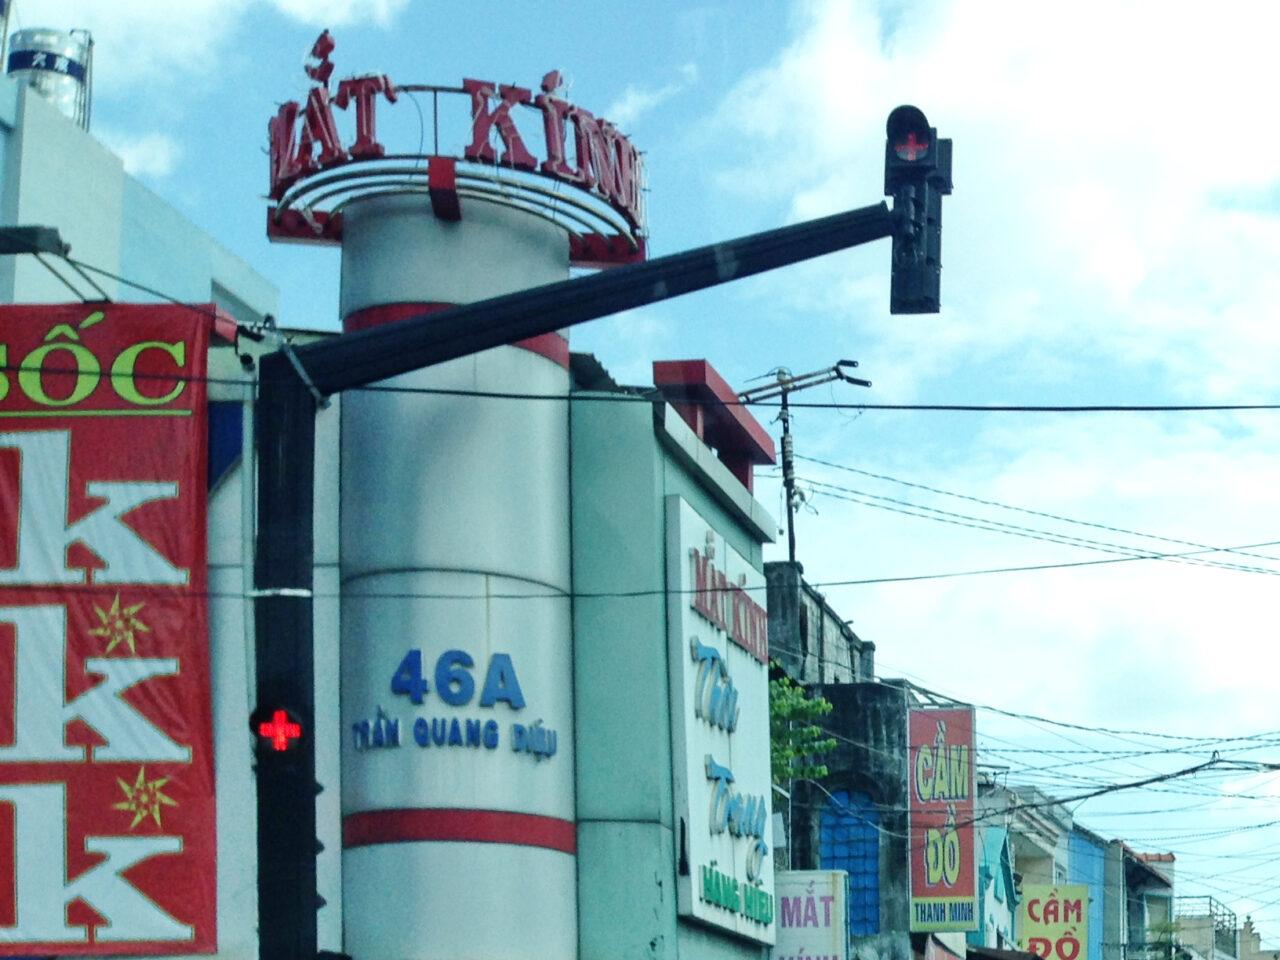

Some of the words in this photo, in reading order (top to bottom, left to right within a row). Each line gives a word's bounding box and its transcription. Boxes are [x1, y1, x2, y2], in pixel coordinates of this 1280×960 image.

[0, 311, 187, 404] ỐC
[391, 648, 526, 710] 46A
[413, 717, 499, 749] QUANG
[916, 720, 969, 803] CẦM
[925, 805, 961, 888] ĐỒ
[781, 880, 834, 928] MẮT
[914, 901, 946, 923] THANH
[950, 901, 974, 922] MINH
[1027, 888, 1082, 923] CẦM
[1027, 927, 1081, 960] ĐỒ
